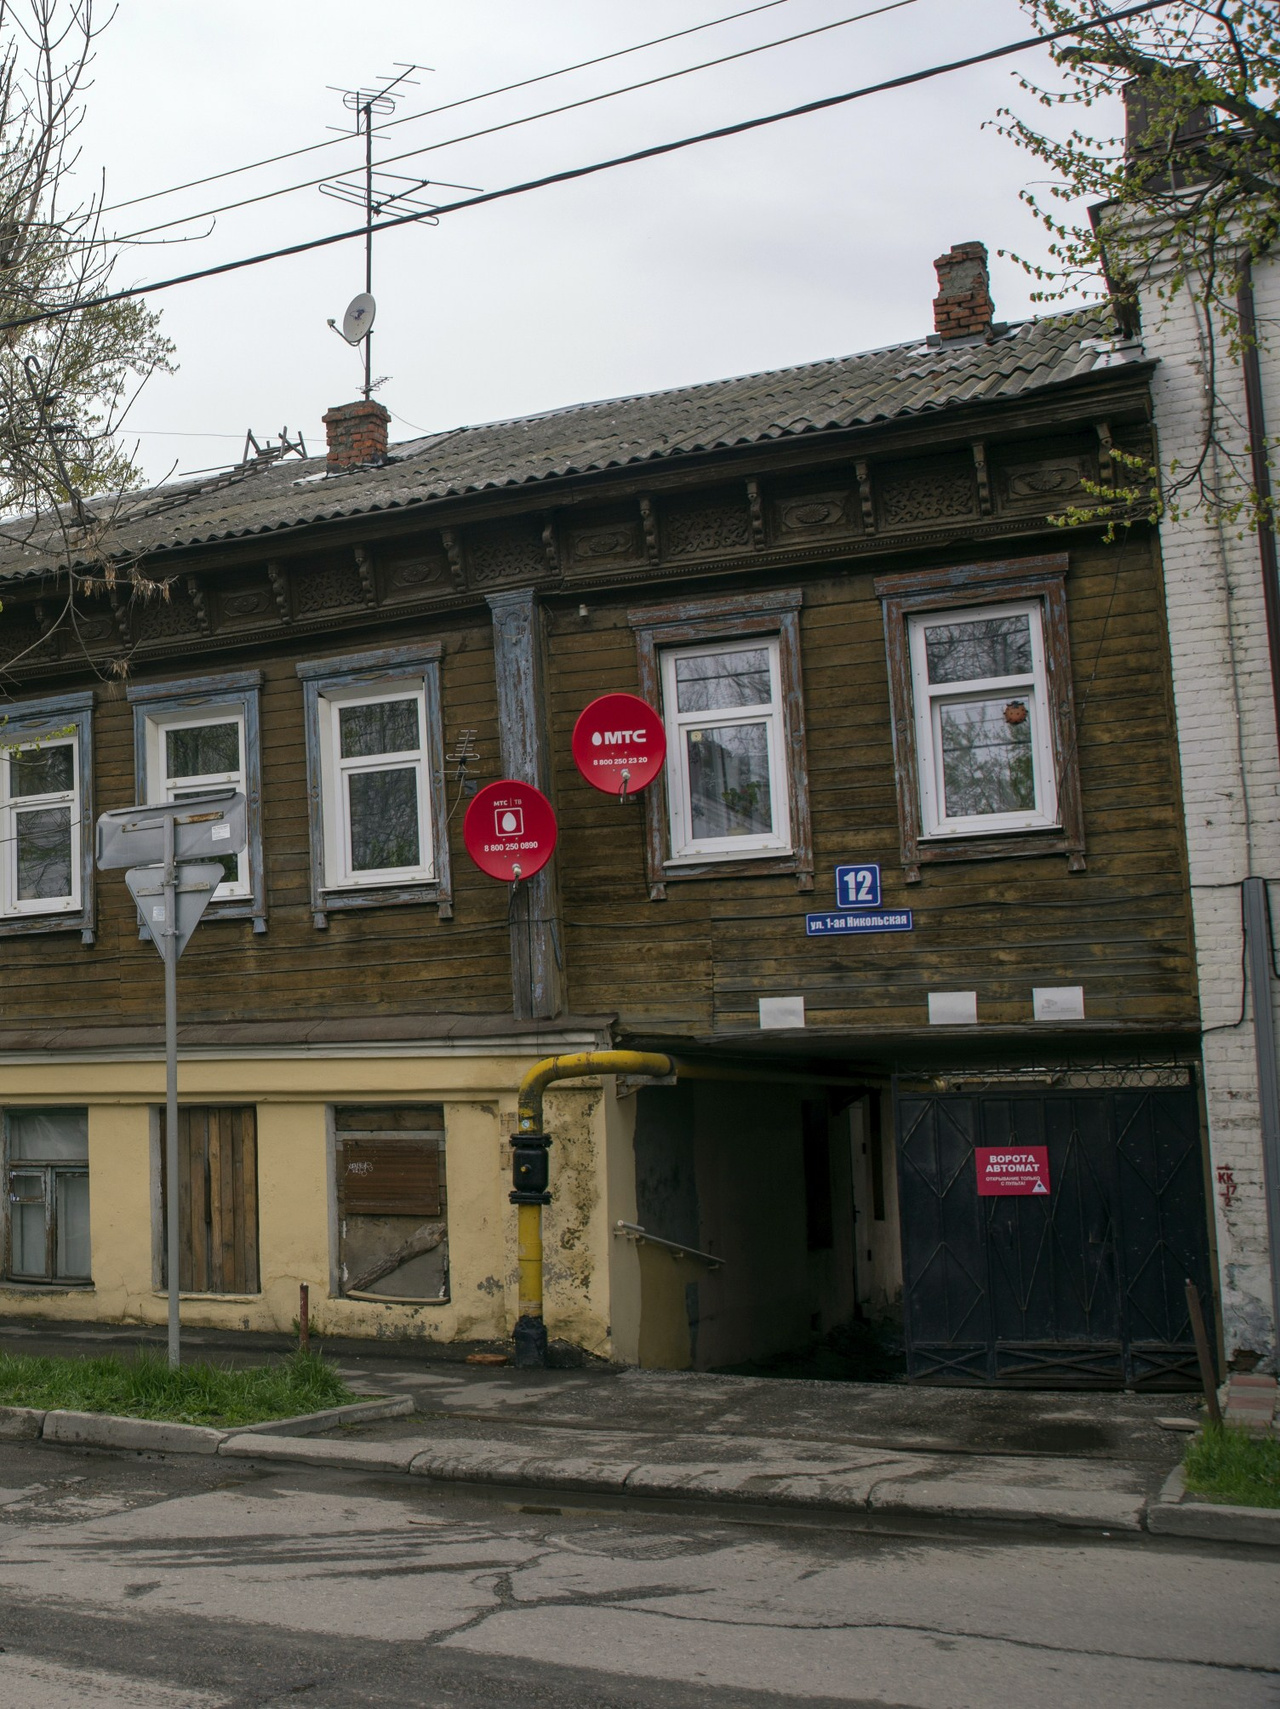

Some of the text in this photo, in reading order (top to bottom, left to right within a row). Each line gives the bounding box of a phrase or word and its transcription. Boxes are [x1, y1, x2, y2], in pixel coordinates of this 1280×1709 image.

[604, 729, 647, 745] МТС
[599, 758, 613, 766] 800
[614, 757, 628, 765] 250
[484, 841, 538, 852] 8 800 250 0890
[843, 870, 873, 902] 12
[810, 914, 908, 931] ул. 1-ая Никольская
[989, 1154, 1035, 1164] ВОРОТА
[985, 1164, 1040, 1173] АВТОМАТ
